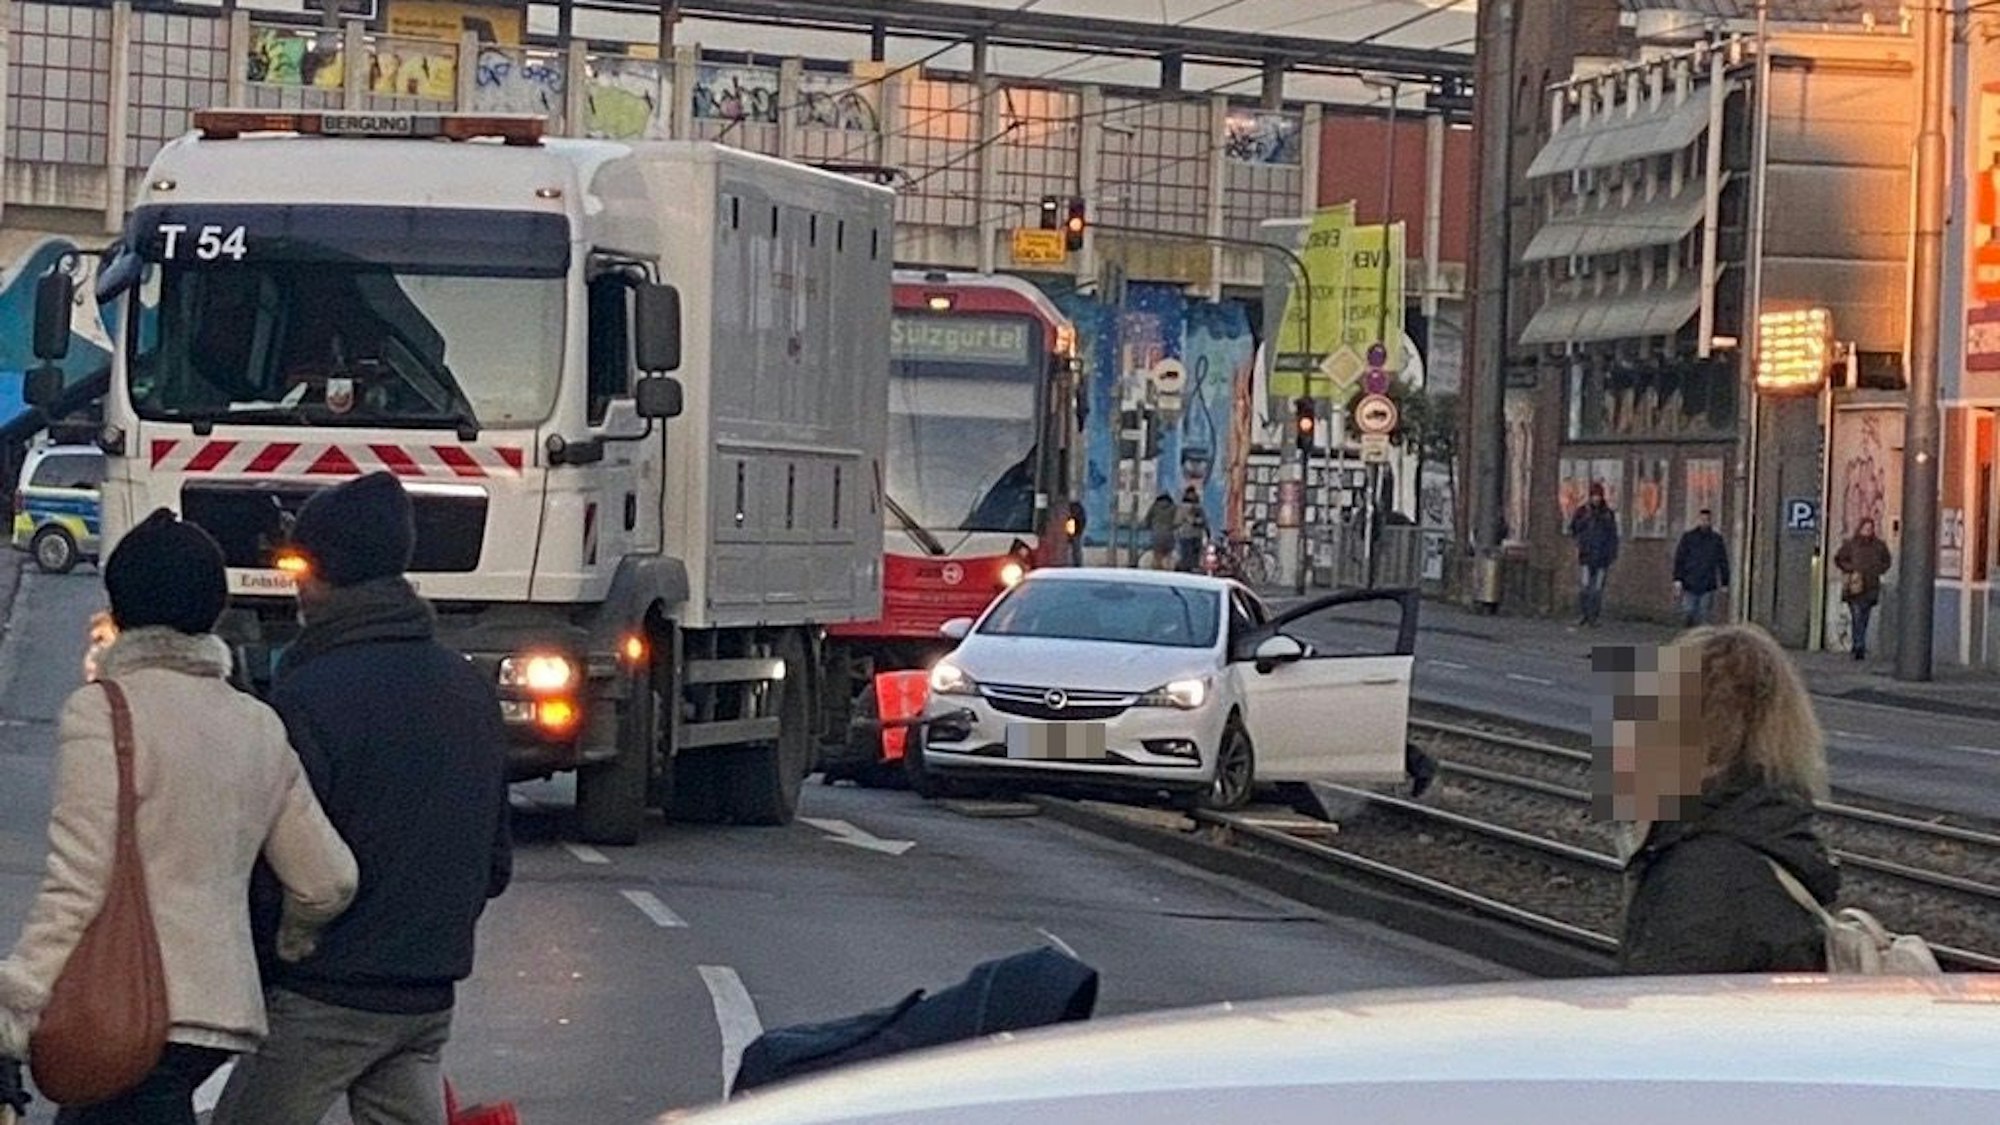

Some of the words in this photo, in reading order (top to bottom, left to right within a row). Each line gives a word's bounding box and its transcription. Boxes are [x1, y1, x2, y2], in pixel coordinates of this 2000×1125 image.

[325, 115, 408, 131] BERGUNG
[158, 224, 187, 260] T
[196, 225, 248, 260] 54
